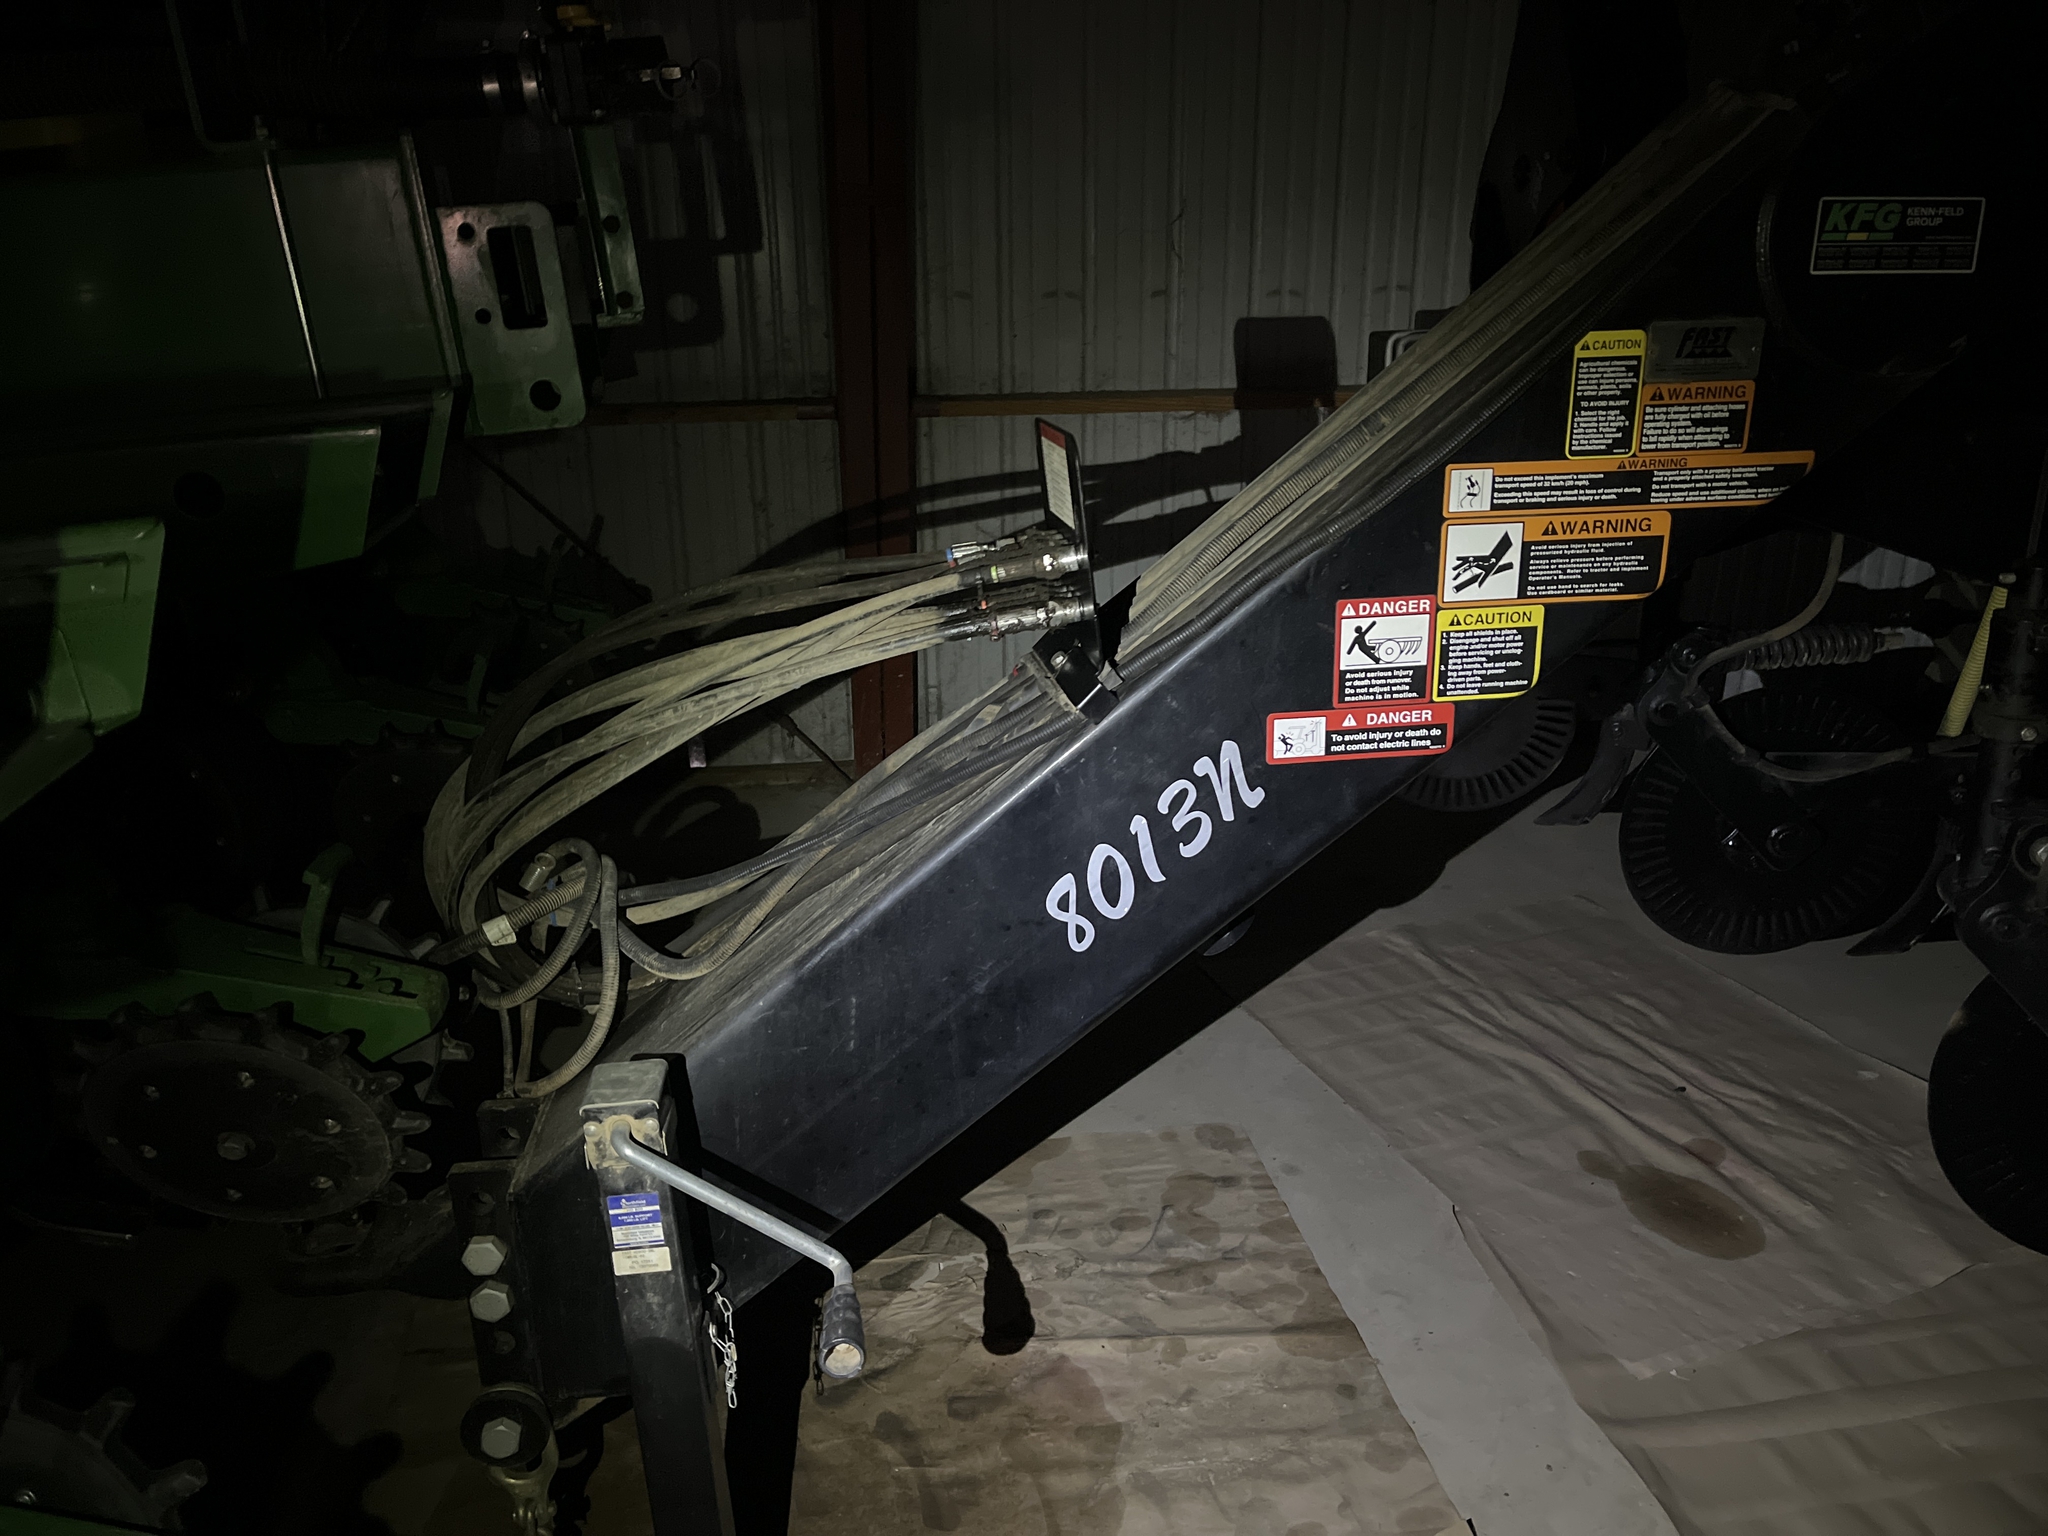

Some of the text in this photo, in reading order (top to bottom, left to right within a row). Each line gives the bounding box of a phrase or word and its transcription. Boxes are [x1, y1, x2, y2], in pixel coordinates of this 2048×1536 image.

[1825, 203, 1902, 231] KFG
[1907, 207, 1964, 216] KENN-FELD
[1906, 217, 1943, 226] GROUP
[1592, 340, 1642, 350] CAUTION
[1676, 326, 1737, 358] FAST
[1668, 385, 1746, 400] WARNING
[1628, 458, 1688, 469] WARNING
[1560, 518, 1652, 535] WARNING
[1359, 599, 1430, 615] DANGER
[1463, 611, 1532, 626] CAUTION
[1366, 710, 1432, 725] DANGER
[1344, 732, 1367, 740] avoid
[1369, 731, 1392, 740] injury
[1405, 728, 1428, 737] death
[1430, 727, 1441, 736] do
[1346, 742, 1377, 750] contact
[1379, 740, 1409, 748] electric
